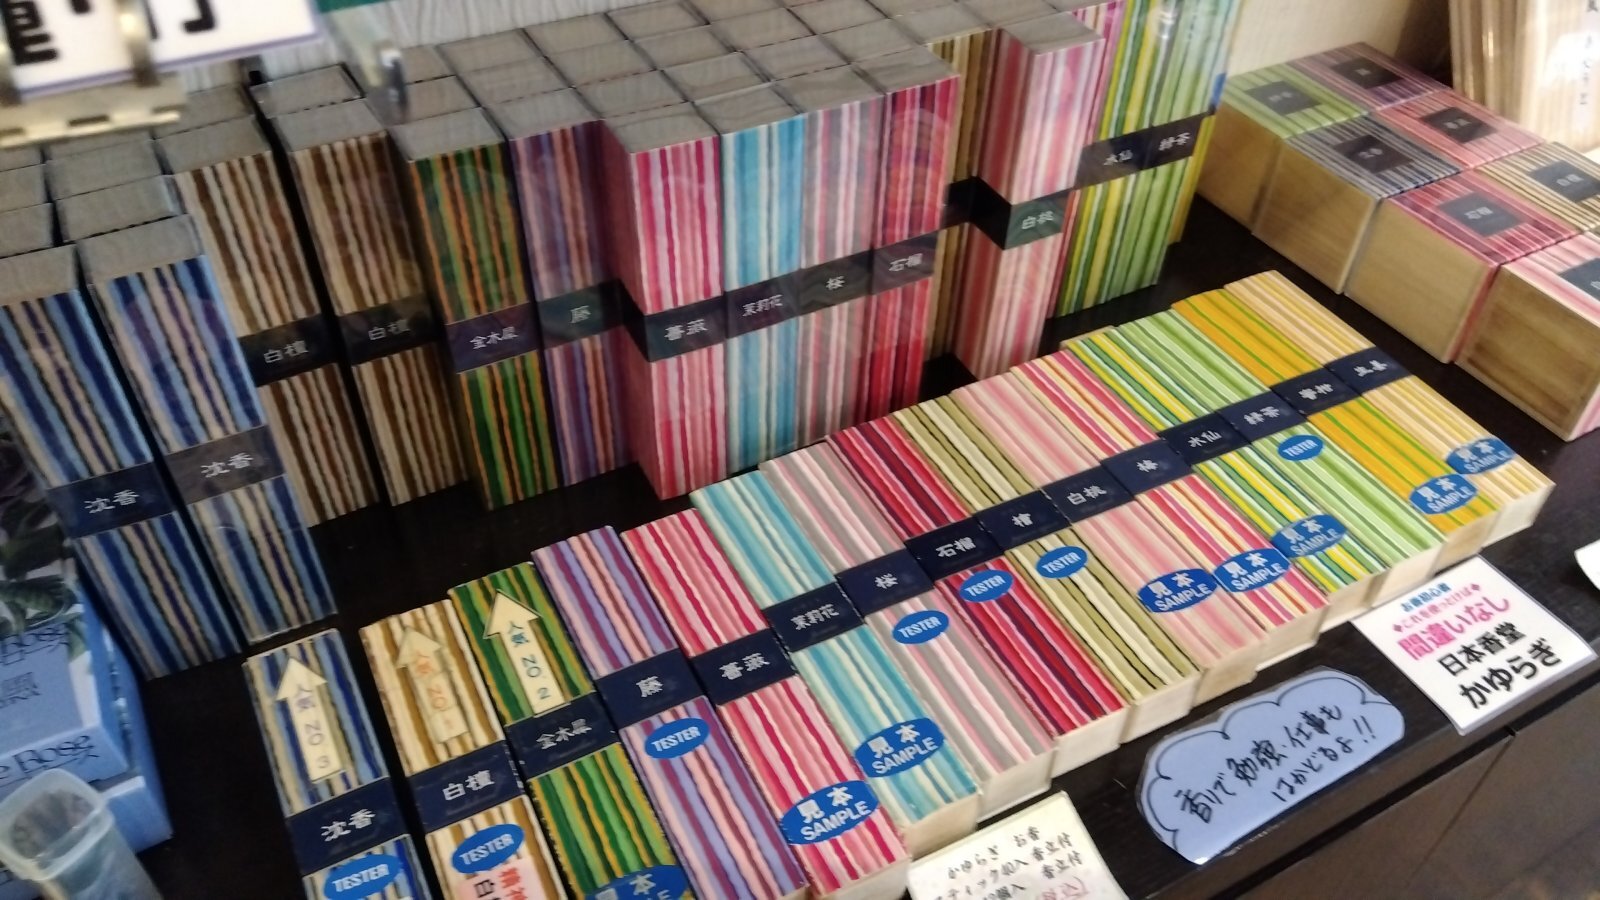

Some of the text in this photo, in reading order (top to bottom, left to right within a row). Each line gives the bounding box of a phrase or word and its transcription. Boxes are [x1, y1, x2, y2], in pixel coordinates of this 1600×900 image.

[264, 340, 309, 364] 白檀
[1283, 439, 1318, 456] TESTER
[1464, 450, 1511, 474] SAMPLE
[1066, 485, 1107, 506] 白桃
[1427, 486, 1475, 513] SAMPLE
[1296, 528, 1346, 557] SAMPLE
[1042, 551, 1082, 574] TESTER
[1226, 552, 1269, 578] 見本
[1232, 562, 1284, 591] SAMPLE
[965, 575, 1005, 597] TESTER
[1148, 572, 1194, 599] 見本
[1156, 582, 1211, 611] SAMPLE
[898, 616, 942, 639] TESTER
[1398, 597, 1510, 660] 間違いなし
[1437, 621, 1527, 676] 日本香堂
[719, 652, 770, 681] 薔薇
[1458, 638, 1563, 709] かゆらぎ
[635, 676, 664, 698] 藤
[651, 727, 702, 752] TESTER
[868, 723, 920, 757] 見本
[871, 737, 939, 775] SAMPLE
[443, 768, 495, 801] 白檀
[796, 786, 853, 820] 見本
[320, 808, 376, 842] 沈香
[801, 801, 872, 842] SAMPLE
[459, 833, 515, 866] TESTER
[332, 863, 390, 894] TESTER
